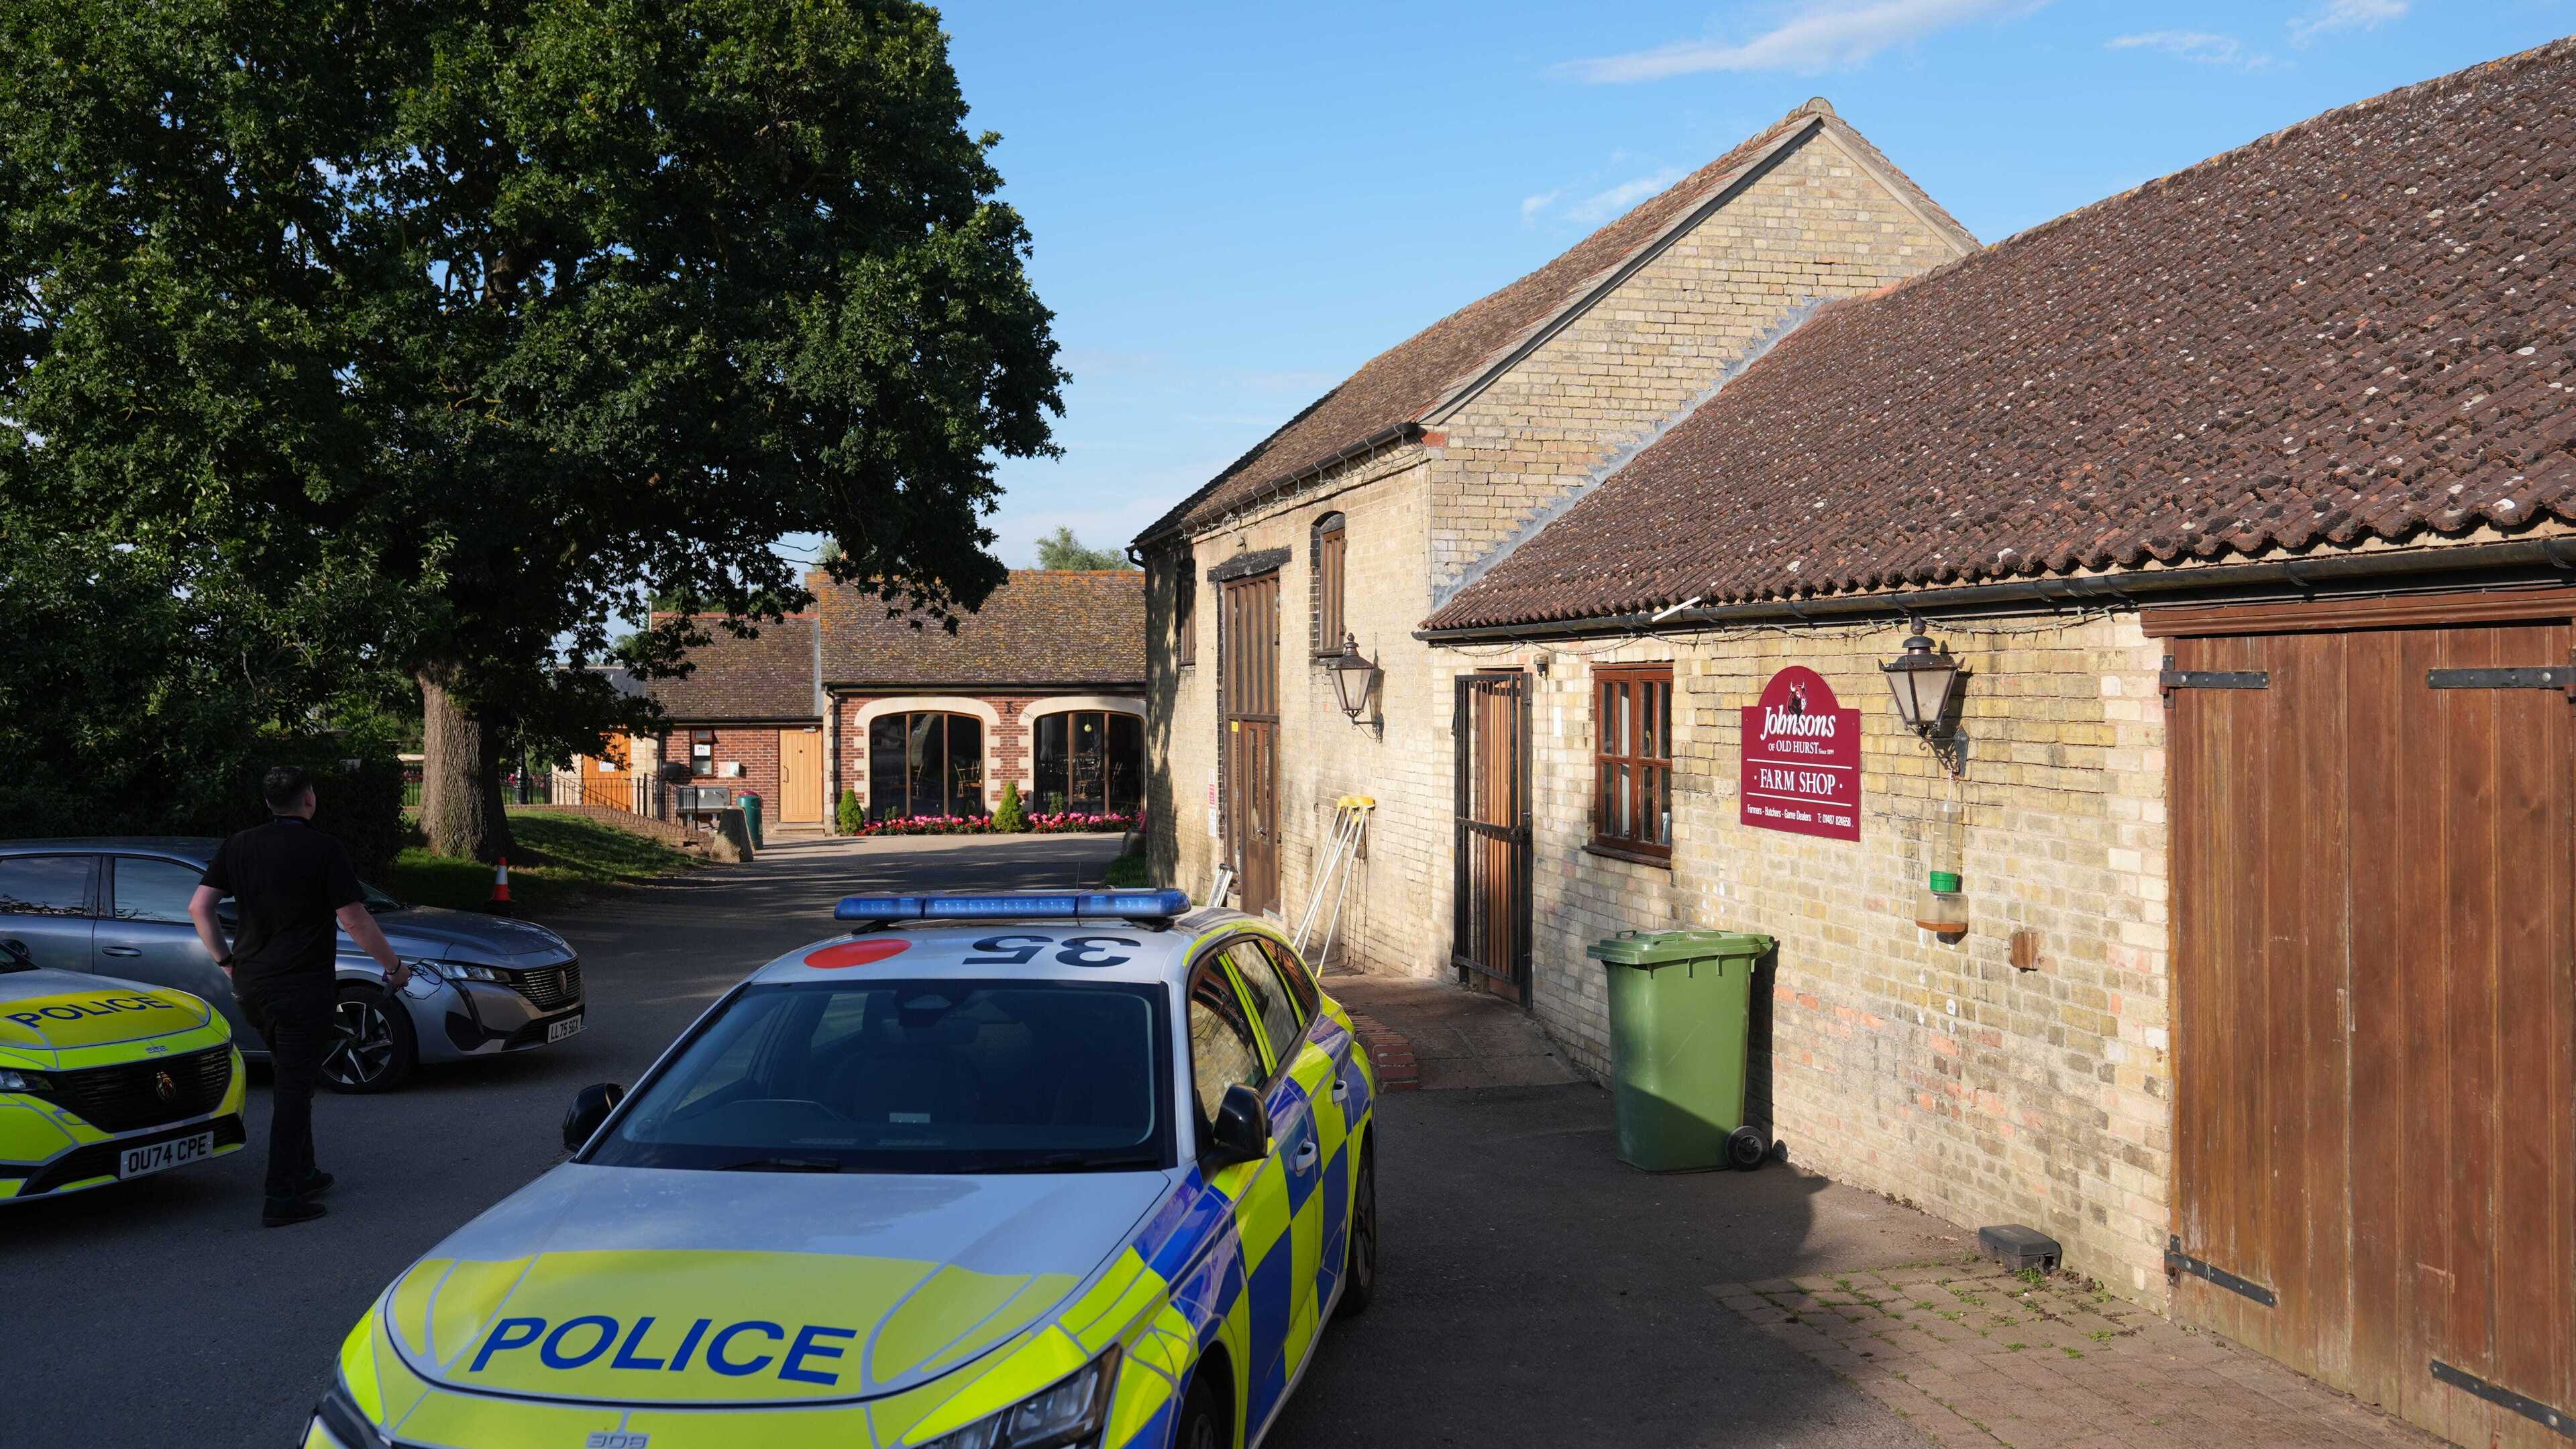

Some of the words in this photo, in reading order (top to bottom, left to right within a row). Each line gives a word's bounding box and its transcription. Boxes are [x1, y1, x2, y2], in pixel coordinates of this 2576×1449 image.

[1760, 704, 1836, 741] Johnsons
[1768, 743, 1776, 751] OF
[1776, 740, 1792, 752] OLD
[1792, 741, 1819, 754] HURST
[1760, 768, 1795, 792] FARM
[1799, 771, 1835, 795] SHOP
[1747, 804, 1762, 815] Farmers
[1764, 806, 1782, 818] Butchers
[1784, 808, 1796, 820] Game
[1796, 810, 1812, 822] Dealers
[4, 997, 174, 1028] POLICE
[128, 1144, 172, 1173] OU74
[177, 1135, 207, 1161] CPE
[468, 1314, 858, 1386] POLICE
